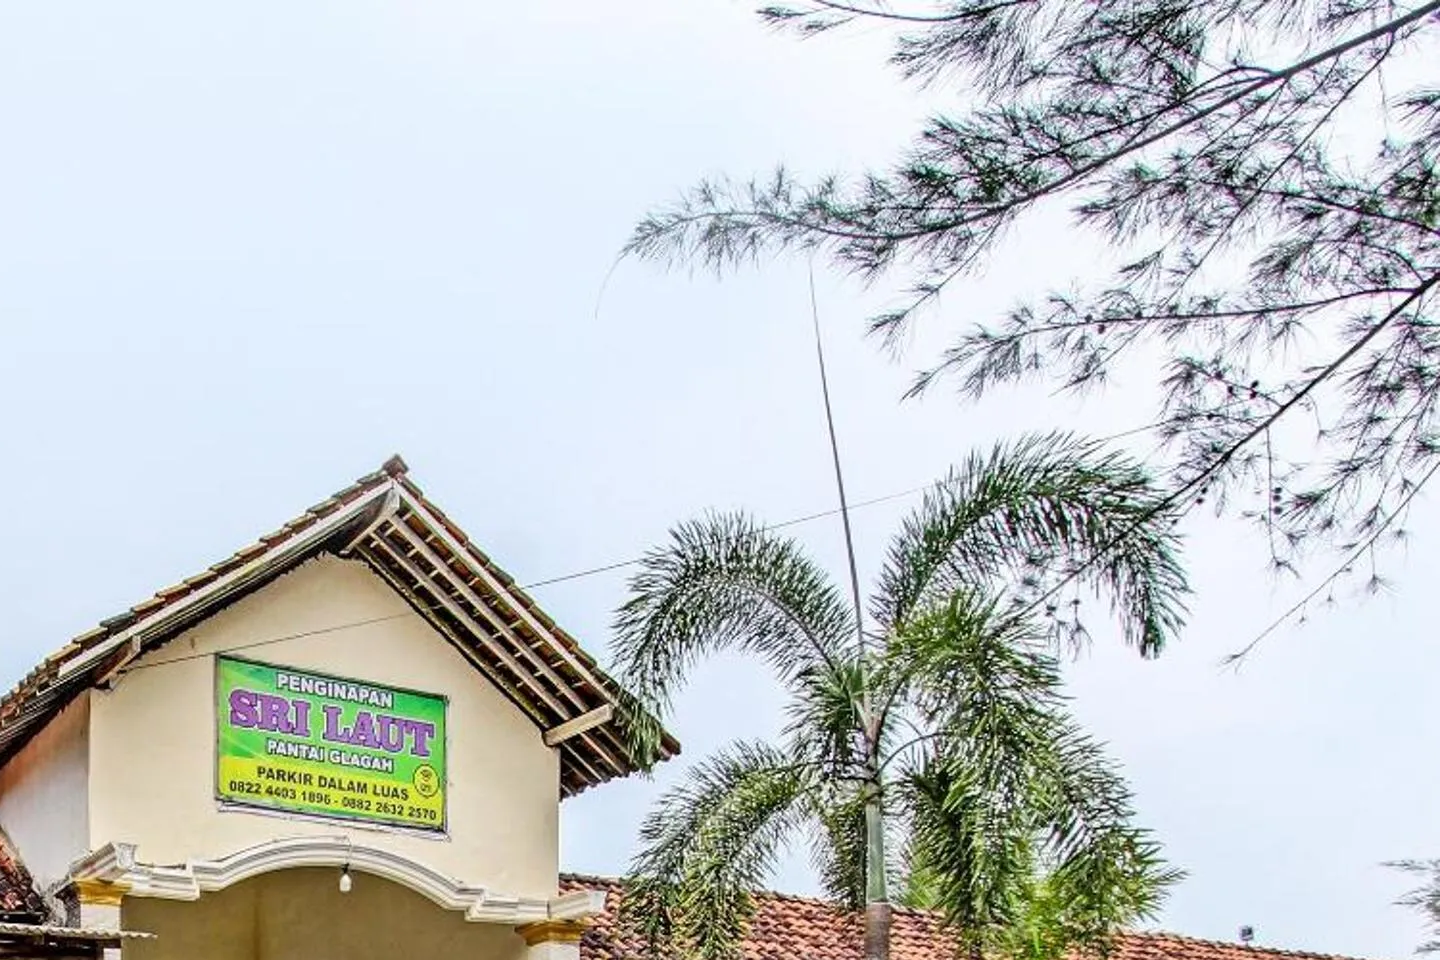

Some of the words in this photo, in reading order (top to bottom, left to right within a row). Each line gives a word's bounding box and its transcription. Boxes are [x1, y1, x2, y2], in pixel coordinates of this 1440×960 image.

[277, 673, 394, 708] PENGINAPAN
[229, 688, 311, 738] SRI
[323, 705, 435, 757] LAUT
[267, 738, 325, 763] PANTAI
[329, 750, 395, 773] GLAGAH
[229, 780, 262, 796] 0822
[408, 806, 438, 821] 2570
[257, 765, 313, 787] PARKIR
[318, 775, 368, 796] DALAM
[372, 782, 410, 801] LUAS
